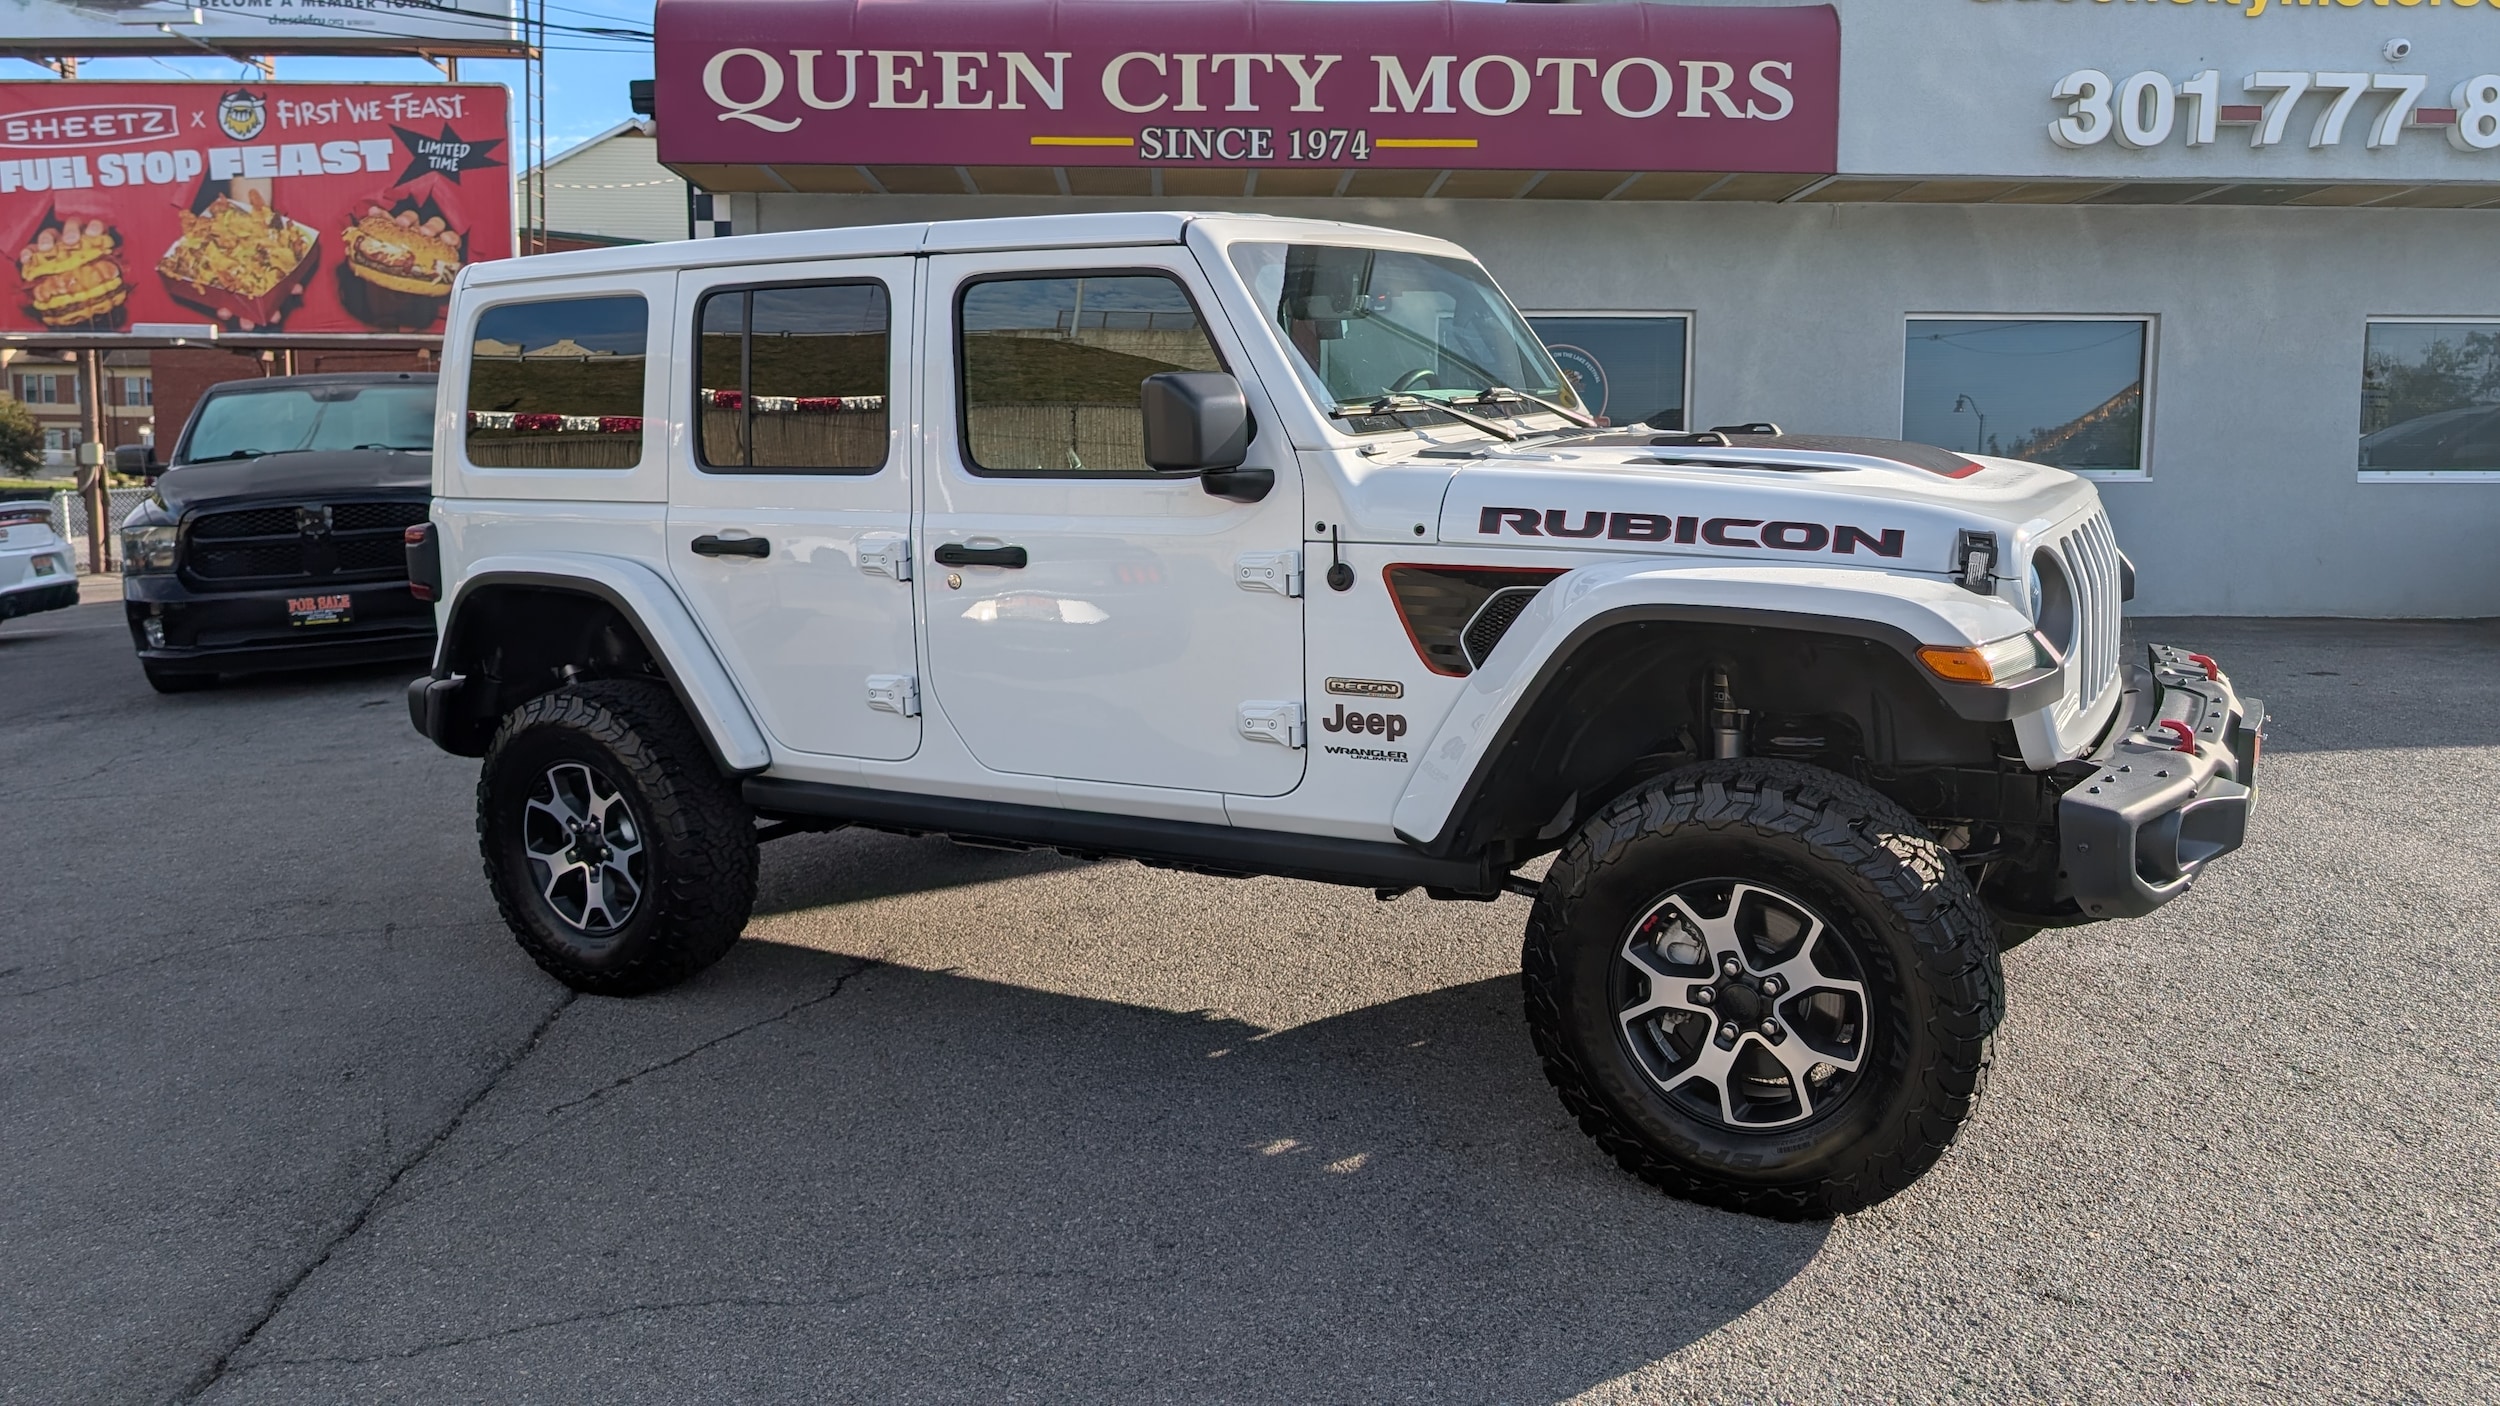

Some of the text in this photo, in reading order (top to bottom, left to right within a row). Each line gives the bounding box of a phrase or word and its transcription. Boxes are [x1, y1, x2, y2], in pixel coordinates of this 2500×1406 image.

[703, 48, 1794, 133] QUEEN CITY MOTORS
[6, 111, 165, 142] SHEETZ
[277, 99, 342, 129] FIRST
[345, 97, 383, 123] WE
[385, 92, 467, 121] FEAST
[418, 139, 471, 159] LIMITED
[1140, 127, 1370, 160] SINCE 1974
[0, 139, 394, 194] FUEL STOP FEAST
[428, 156, 459, 172] TIME
[1585, 361, 1601, 383] FESTIVAL
[1479, 506, 1906, 558] RUBICON
[288, 597, 316, 613] FOR
[317, 594, 351, 609] SALE
[1331, 681, 1397, 693] RECON
[1323, 704, 1408, 742] Jeep
[1324, 745, 1408, 759] WRANGLER
[1350, 754, 1409, 763] UNLIMITED
